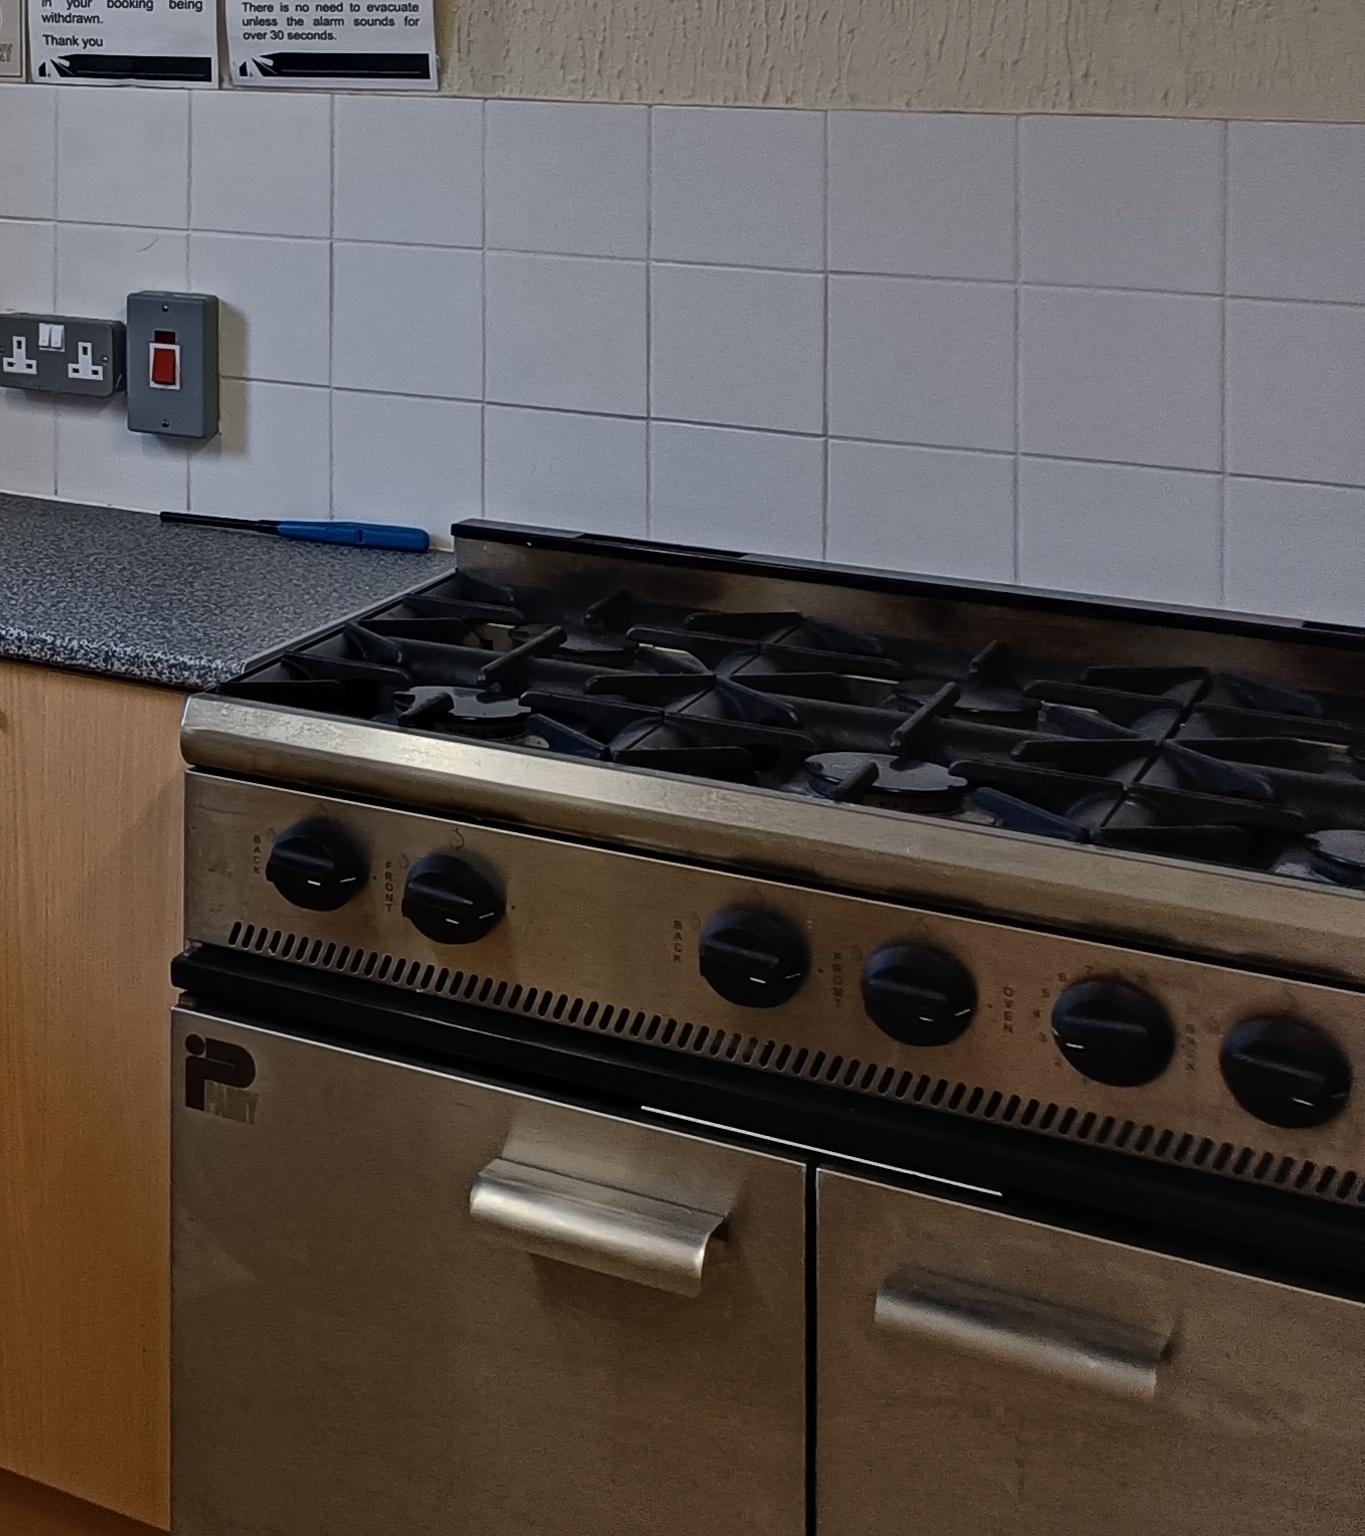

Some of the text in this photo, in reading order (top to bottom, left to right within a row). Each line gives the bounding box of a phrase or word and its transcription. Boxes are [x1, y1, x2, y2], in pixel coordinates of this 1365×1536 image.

[42, 13, 104, 25] withdrawn.
[242, 15, 420, 27] unless the alarm sounds for
[43, 35, 104, 50] Thank you
